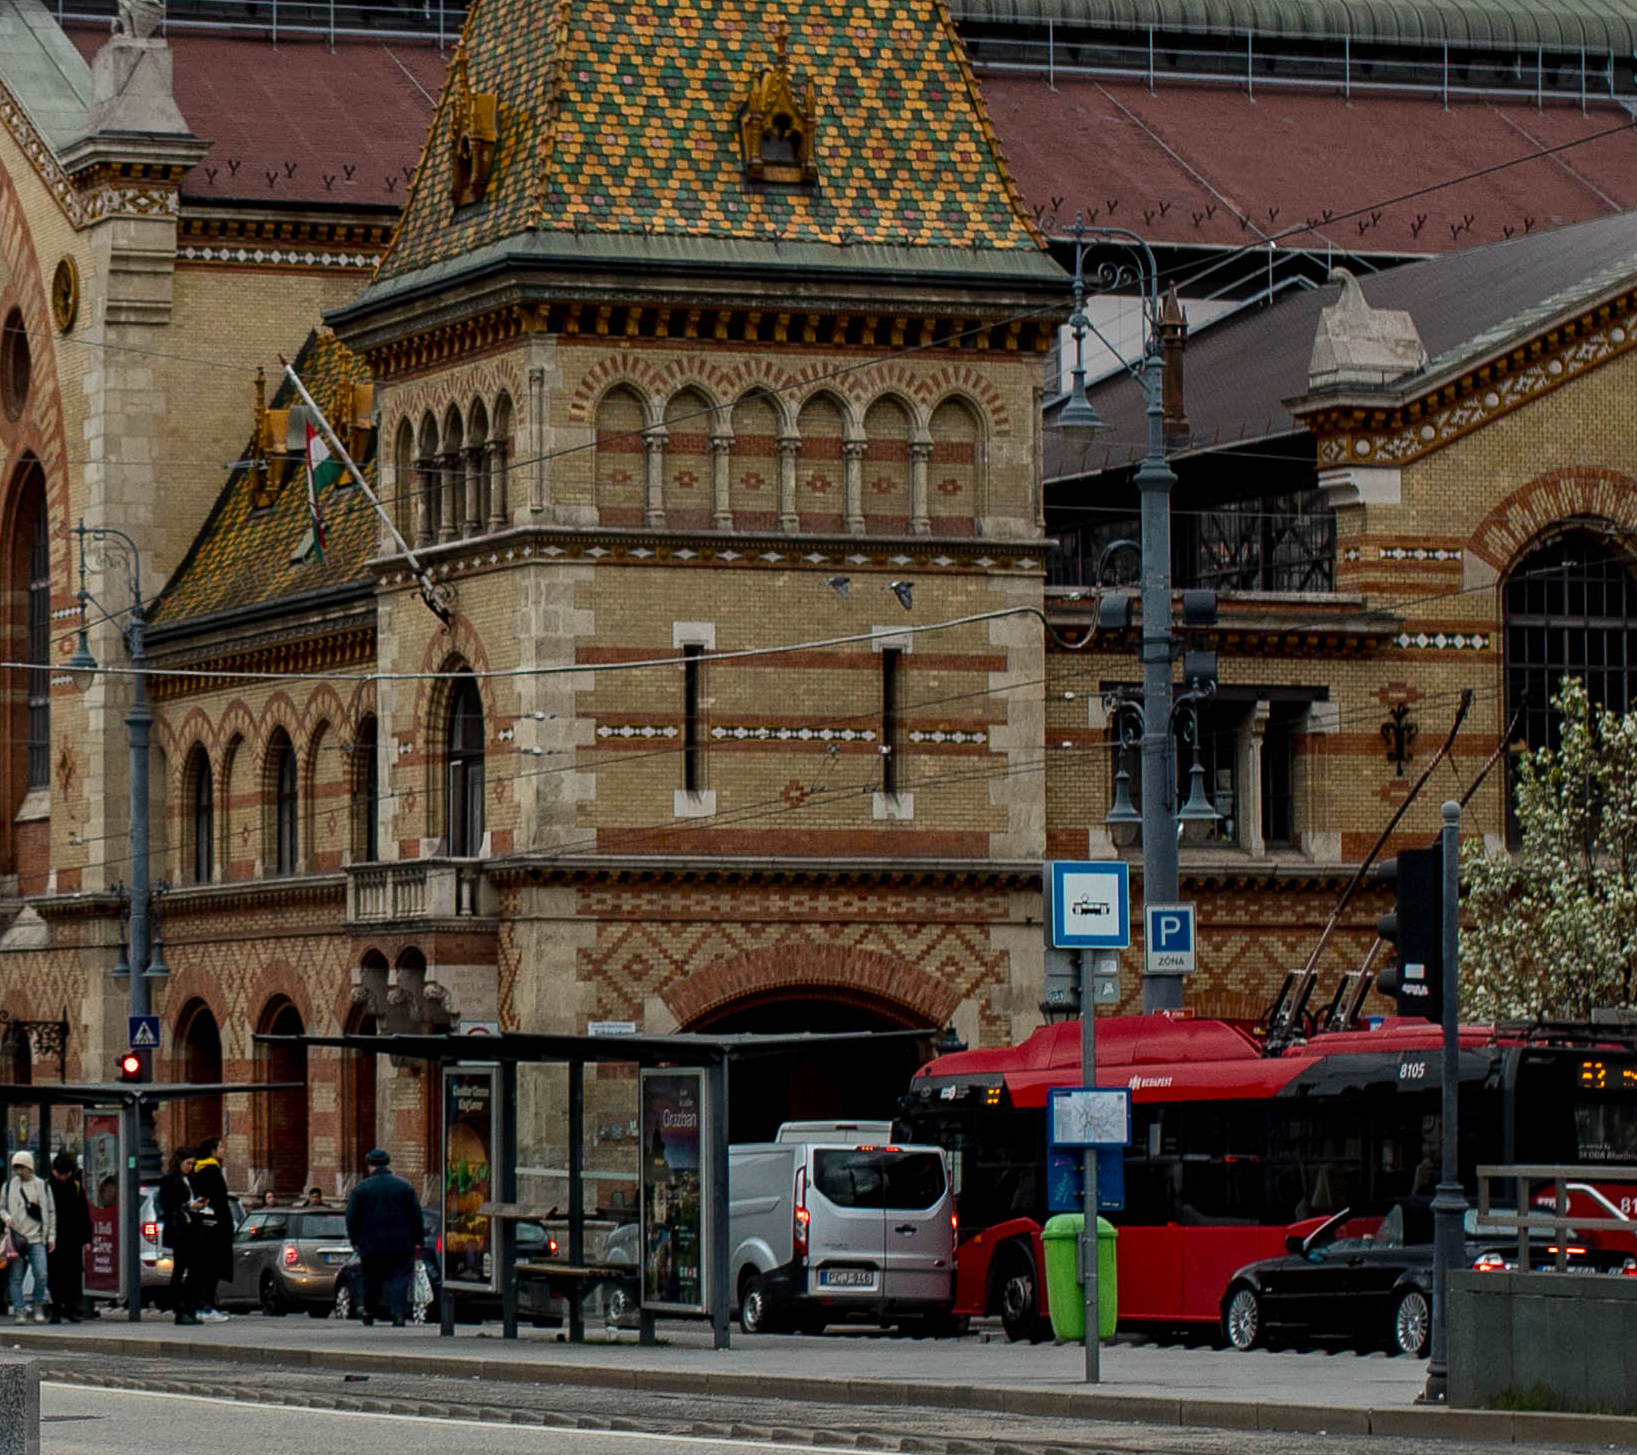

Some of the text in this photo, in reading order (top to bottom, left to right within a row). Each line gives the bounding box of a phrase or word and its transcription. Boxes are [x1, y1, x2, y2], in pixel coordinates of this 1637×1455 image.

[1161, 916, 1181, 947] P
[1158, 955, 1184, 967] ZÓNA
[1400, 1062, 1426, 1079] 8105
